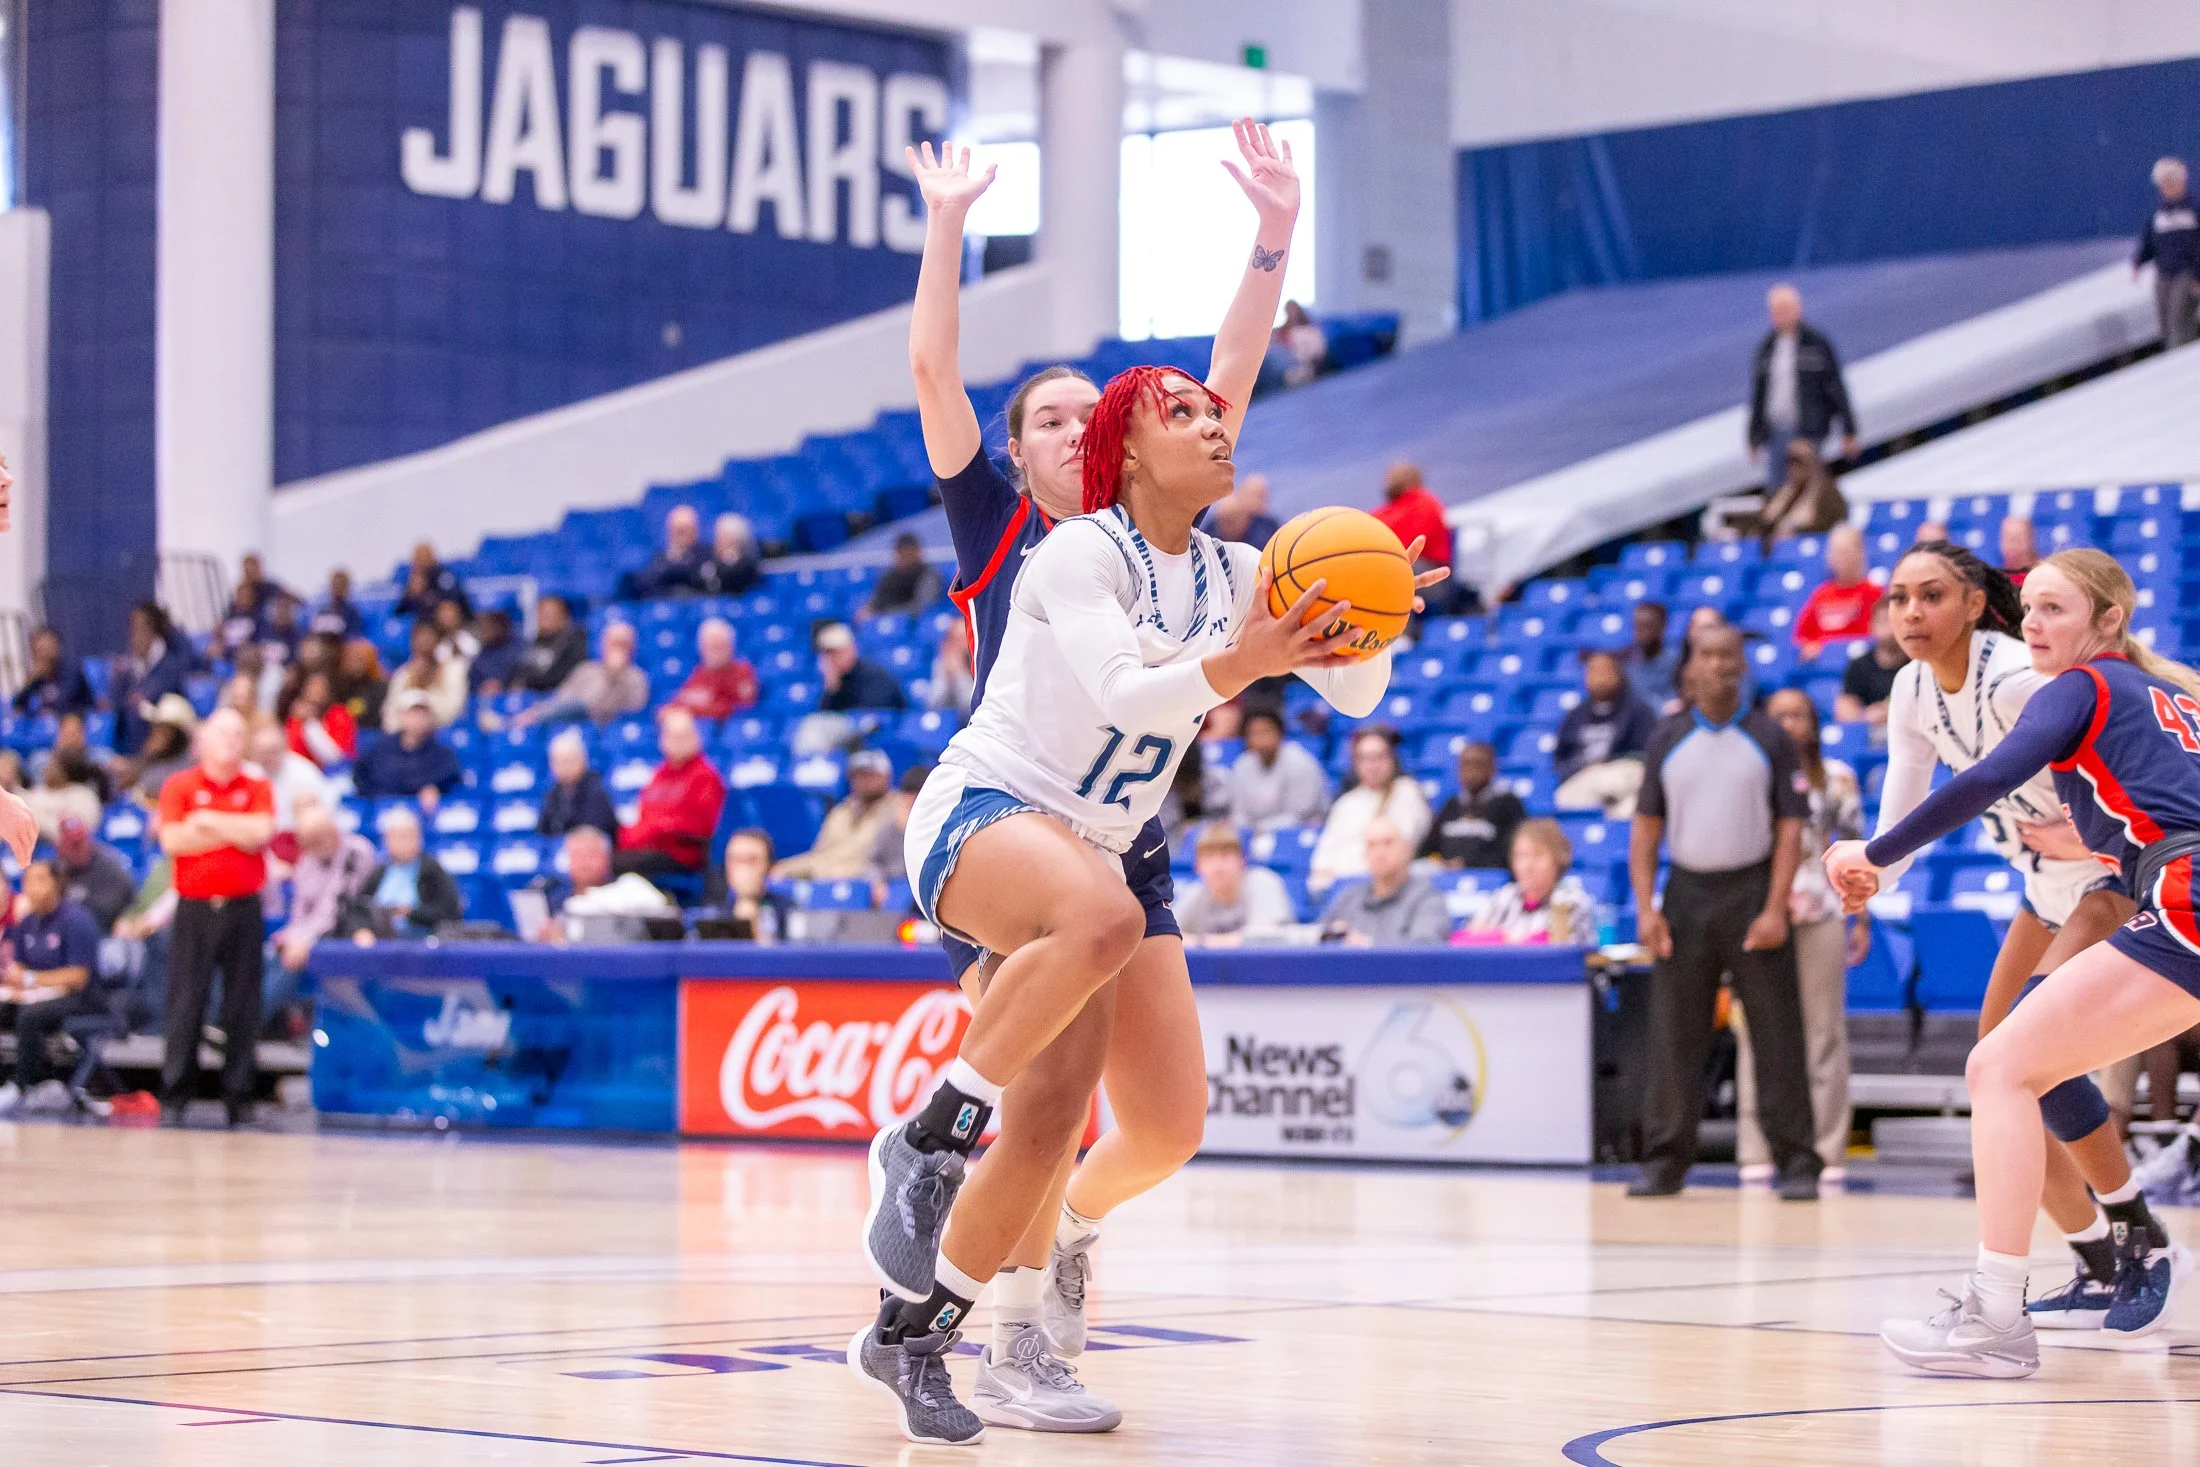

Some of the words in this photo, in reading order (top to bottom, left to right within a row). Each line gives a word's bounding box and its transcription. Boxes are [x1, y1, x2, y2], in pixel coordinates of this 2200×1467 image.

[402, 7, 950, 256] JAGUARS
[1077, 723, 1176, 812] 12
[719, 986, 976, 1129] Coca-Co
[1224, 1034, 1343, 1077] News
